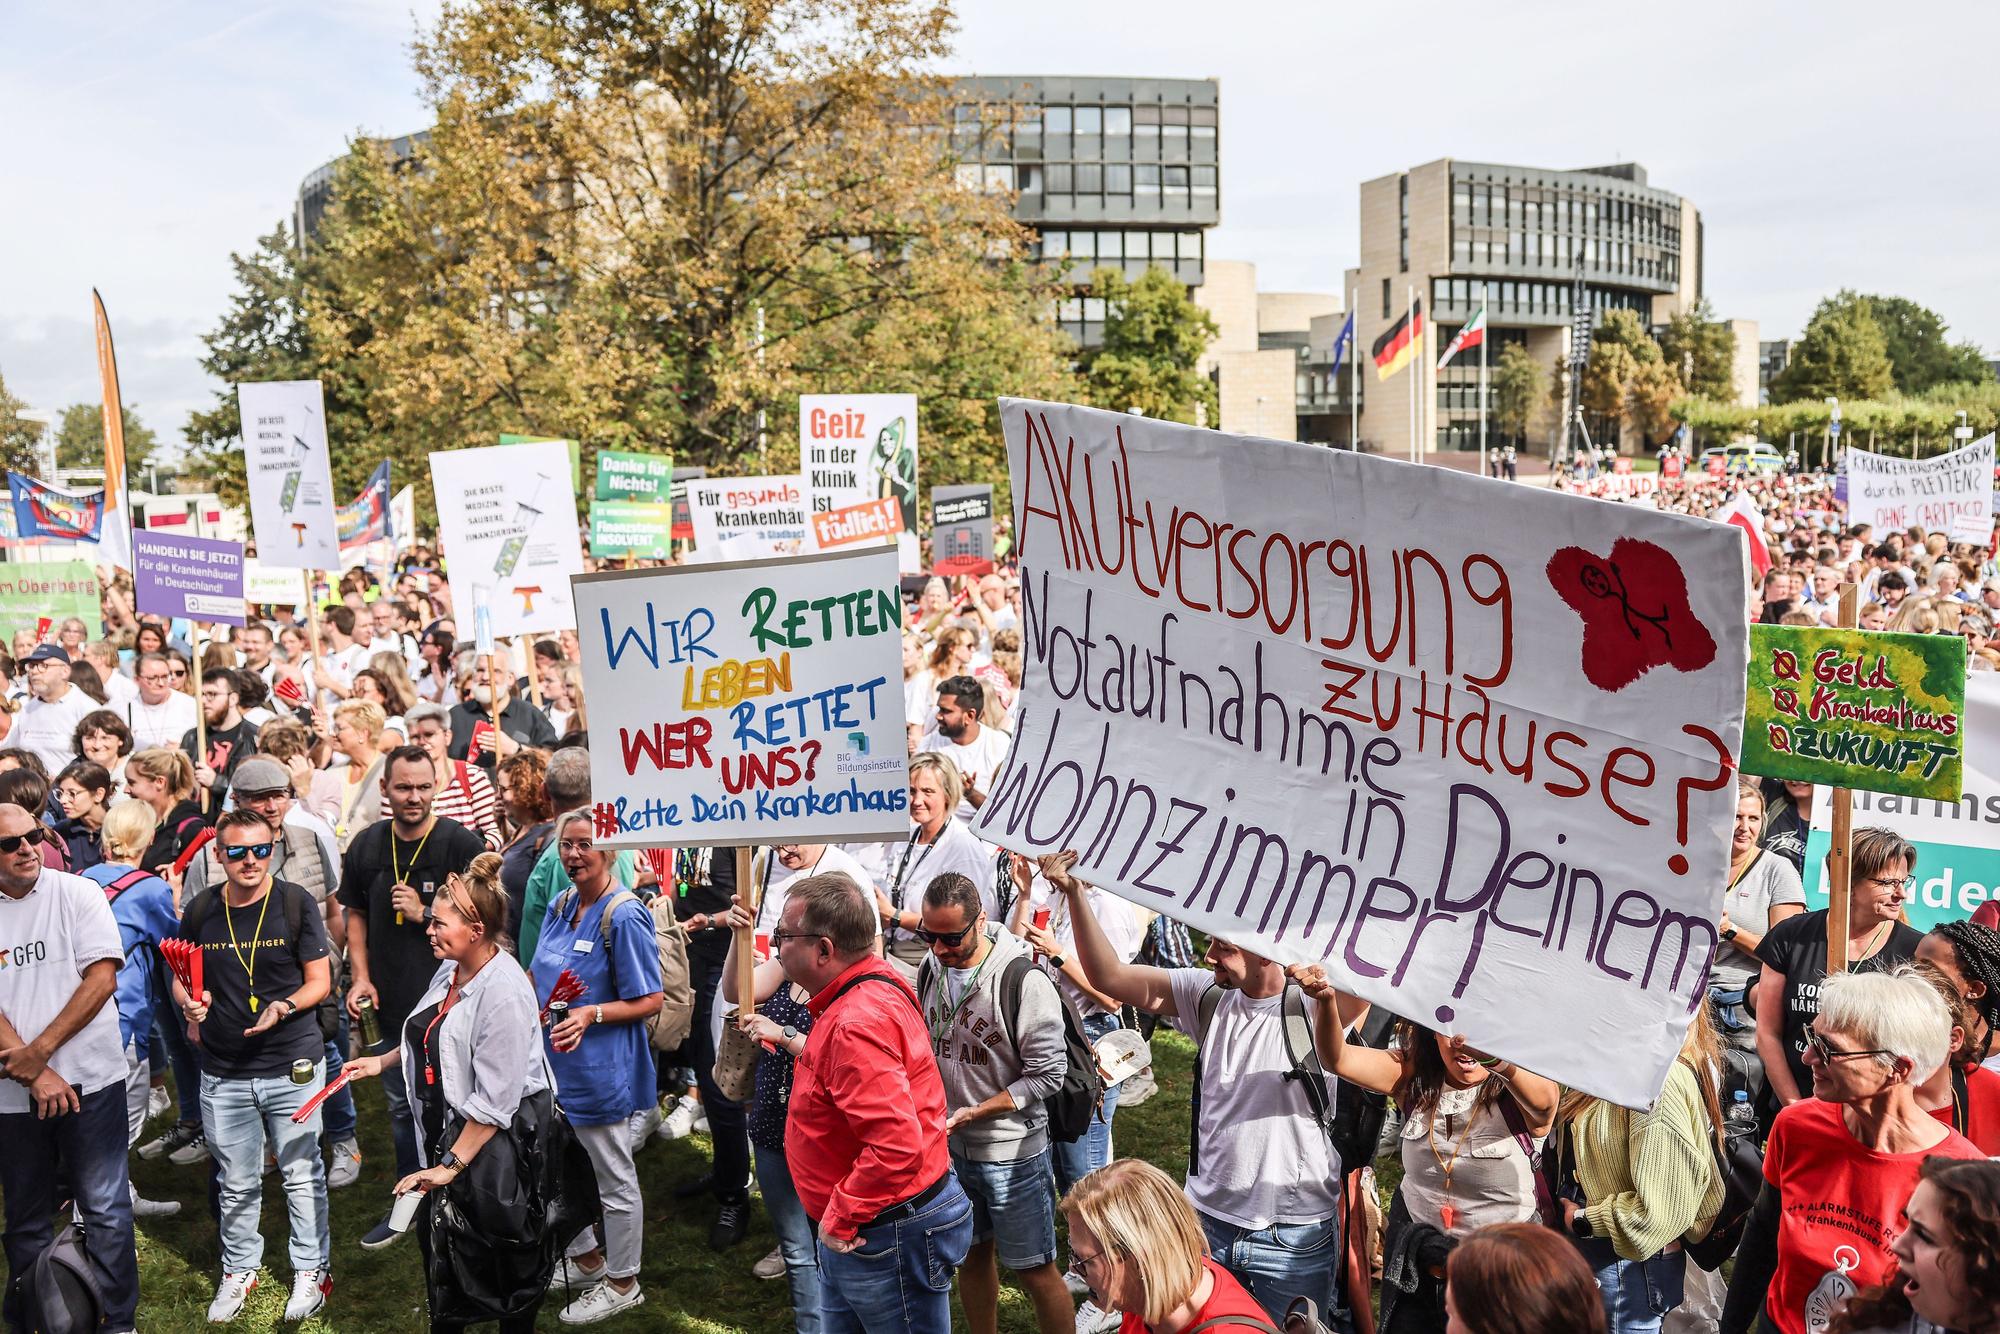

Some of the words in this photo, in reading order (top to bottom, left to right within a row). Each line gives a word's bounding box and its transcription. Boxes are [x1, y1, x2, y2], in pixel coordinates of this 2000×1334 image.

[810, 408, 865, 439] Geiz
[602, 457, 645, 474] Danke
[648, 460, 668, 476] für
[811, 446, 825, 463] in
[831, 446, 857, 463] der
[609, 474, 659, 493] Nichts!
[812, 470, 857, 488] Klinik
[698, 489, 720, 506] Für
[727, 484, 800, 509] gesunde
[813, 495, 832, 512] ist
[818, 500, 896, 542] tödlich!
[138, 542, 187, 559] HANDELN
[189, 549, 206, 561] SIE
[207, 552, 239, 566] JETZT!
[596, 533, 654, 545] INSOLVENT
[139, 559, 155, 569] Für
[156, 561, 170, 572] die
[171, 563, 238, 580] Krankenhäuser
[154, 575, 162, 585] in
[165, 576, 223, 593] Deutschland!
[18, 577, 95, 595] Oberberg
[601, 602, 718, 670] WIR
[741, 585, 902, 653] RETTEN
[681, 652, 792, 711] LEBEN
[1021, 566, 1405, 800] Notaufnahme
[1813, 651, 1897, 688] Geld
[729, 676, 886, 750] RETTET
[1809, 686, 1957, 736] Krankenhaus
[620, 716, 713, 776] WER
[837, 753, 851, 762] BIG
[1794, 727, 1957, 778] ZUKUNFT
[721, 739, 822, 794] UNS?
[837, 760, 901, 774] Bildungsinstitut
[691, 793, 746, 822] Dein
[755, 777, 907, 821] Krankenhaus
[982, 708, 1488, 1023] Wohnzimmer!
[1342, 774, 1405, 876] in
[1434, 784, 1718, 1014] Deinem
[14, 940, 46, 967] GFO
[1807, 1202, 1882, 1232] ALARMSTUFE
